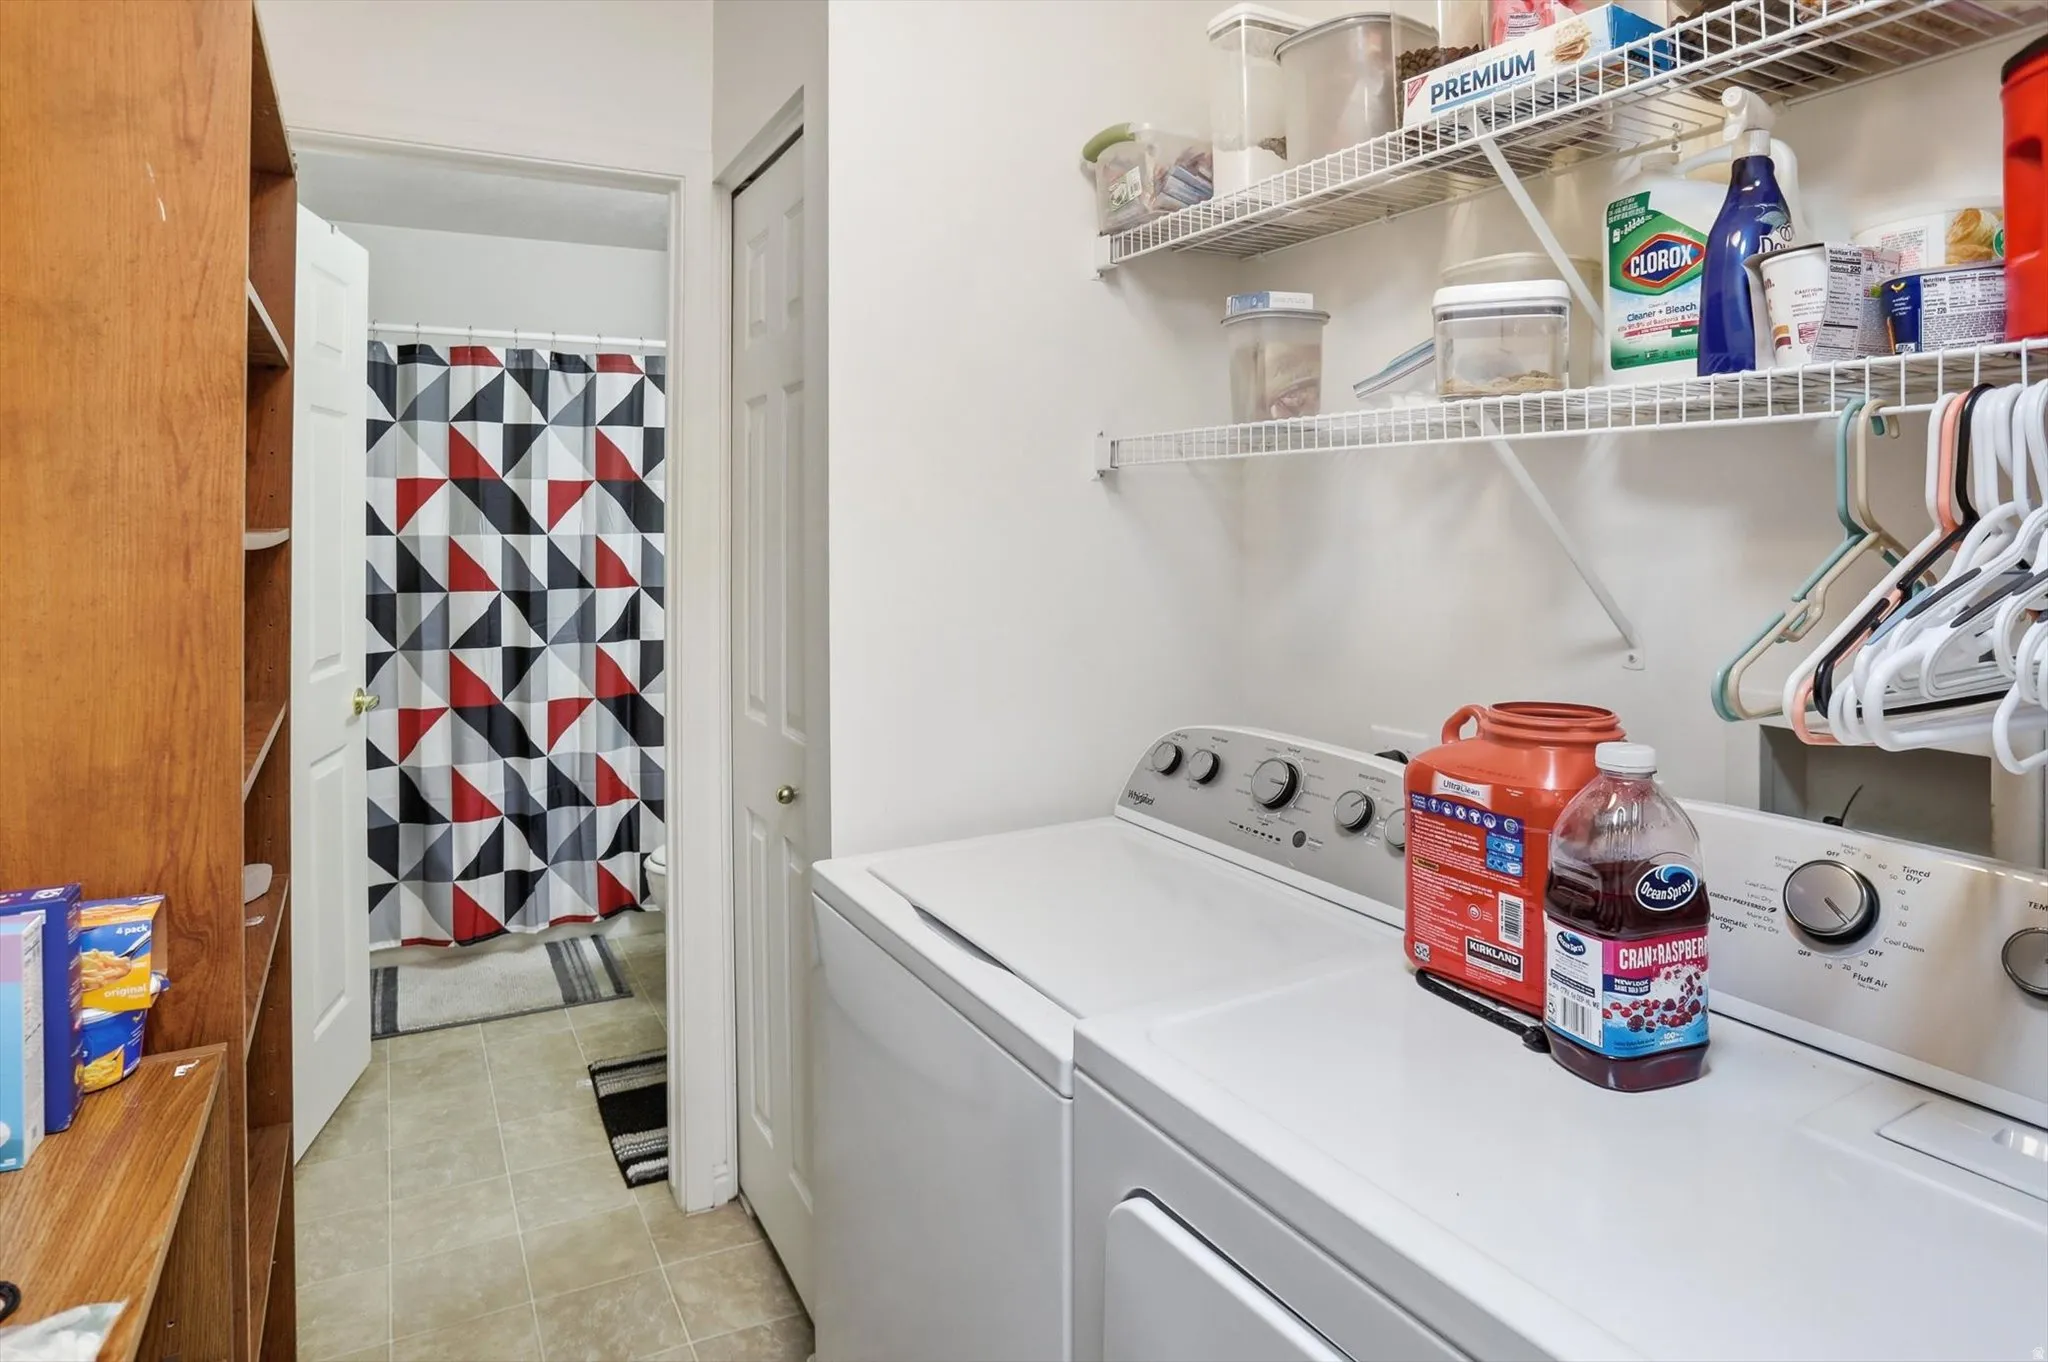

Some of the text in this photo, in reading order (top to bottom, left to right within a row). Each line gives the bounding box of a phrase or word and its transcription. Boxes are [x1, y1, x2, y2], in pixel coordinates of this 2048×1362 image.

[1430, 49, 1536, 105] PREMIUM
[1630, 244, 1693, 278] CLOROX
[1627, 310, 1656, 322] Cleaner
[1665, 302, 1697, 315] Bleach
[1654, 315, 1679, 325] Bacteria
[1443, 779, 1481, 797] UltraClean
[1902, 865, 1931, 878] Timed
[1905, 874, 1922, 884] Dry
[1640, 879, 1692, 902] Ocean Spray
[1709, 891, 1732, 901] ENERGY
[1710, 912, 1748, 929] Automatic
[1720, 922, 1734, 932] Dry
[116, 924, 149, 936] 4 pack
[1469, 939, 1519, 966] KIRKLAND
[1797, 949, 1812, 957] OFF
[1868, 949, 1884, 957] OFF
[1613, 977, 1649, 987] NEW LOOK
[1852, 972, 1888, 988] Fluff Air
[104, 983, 147, 998] original
